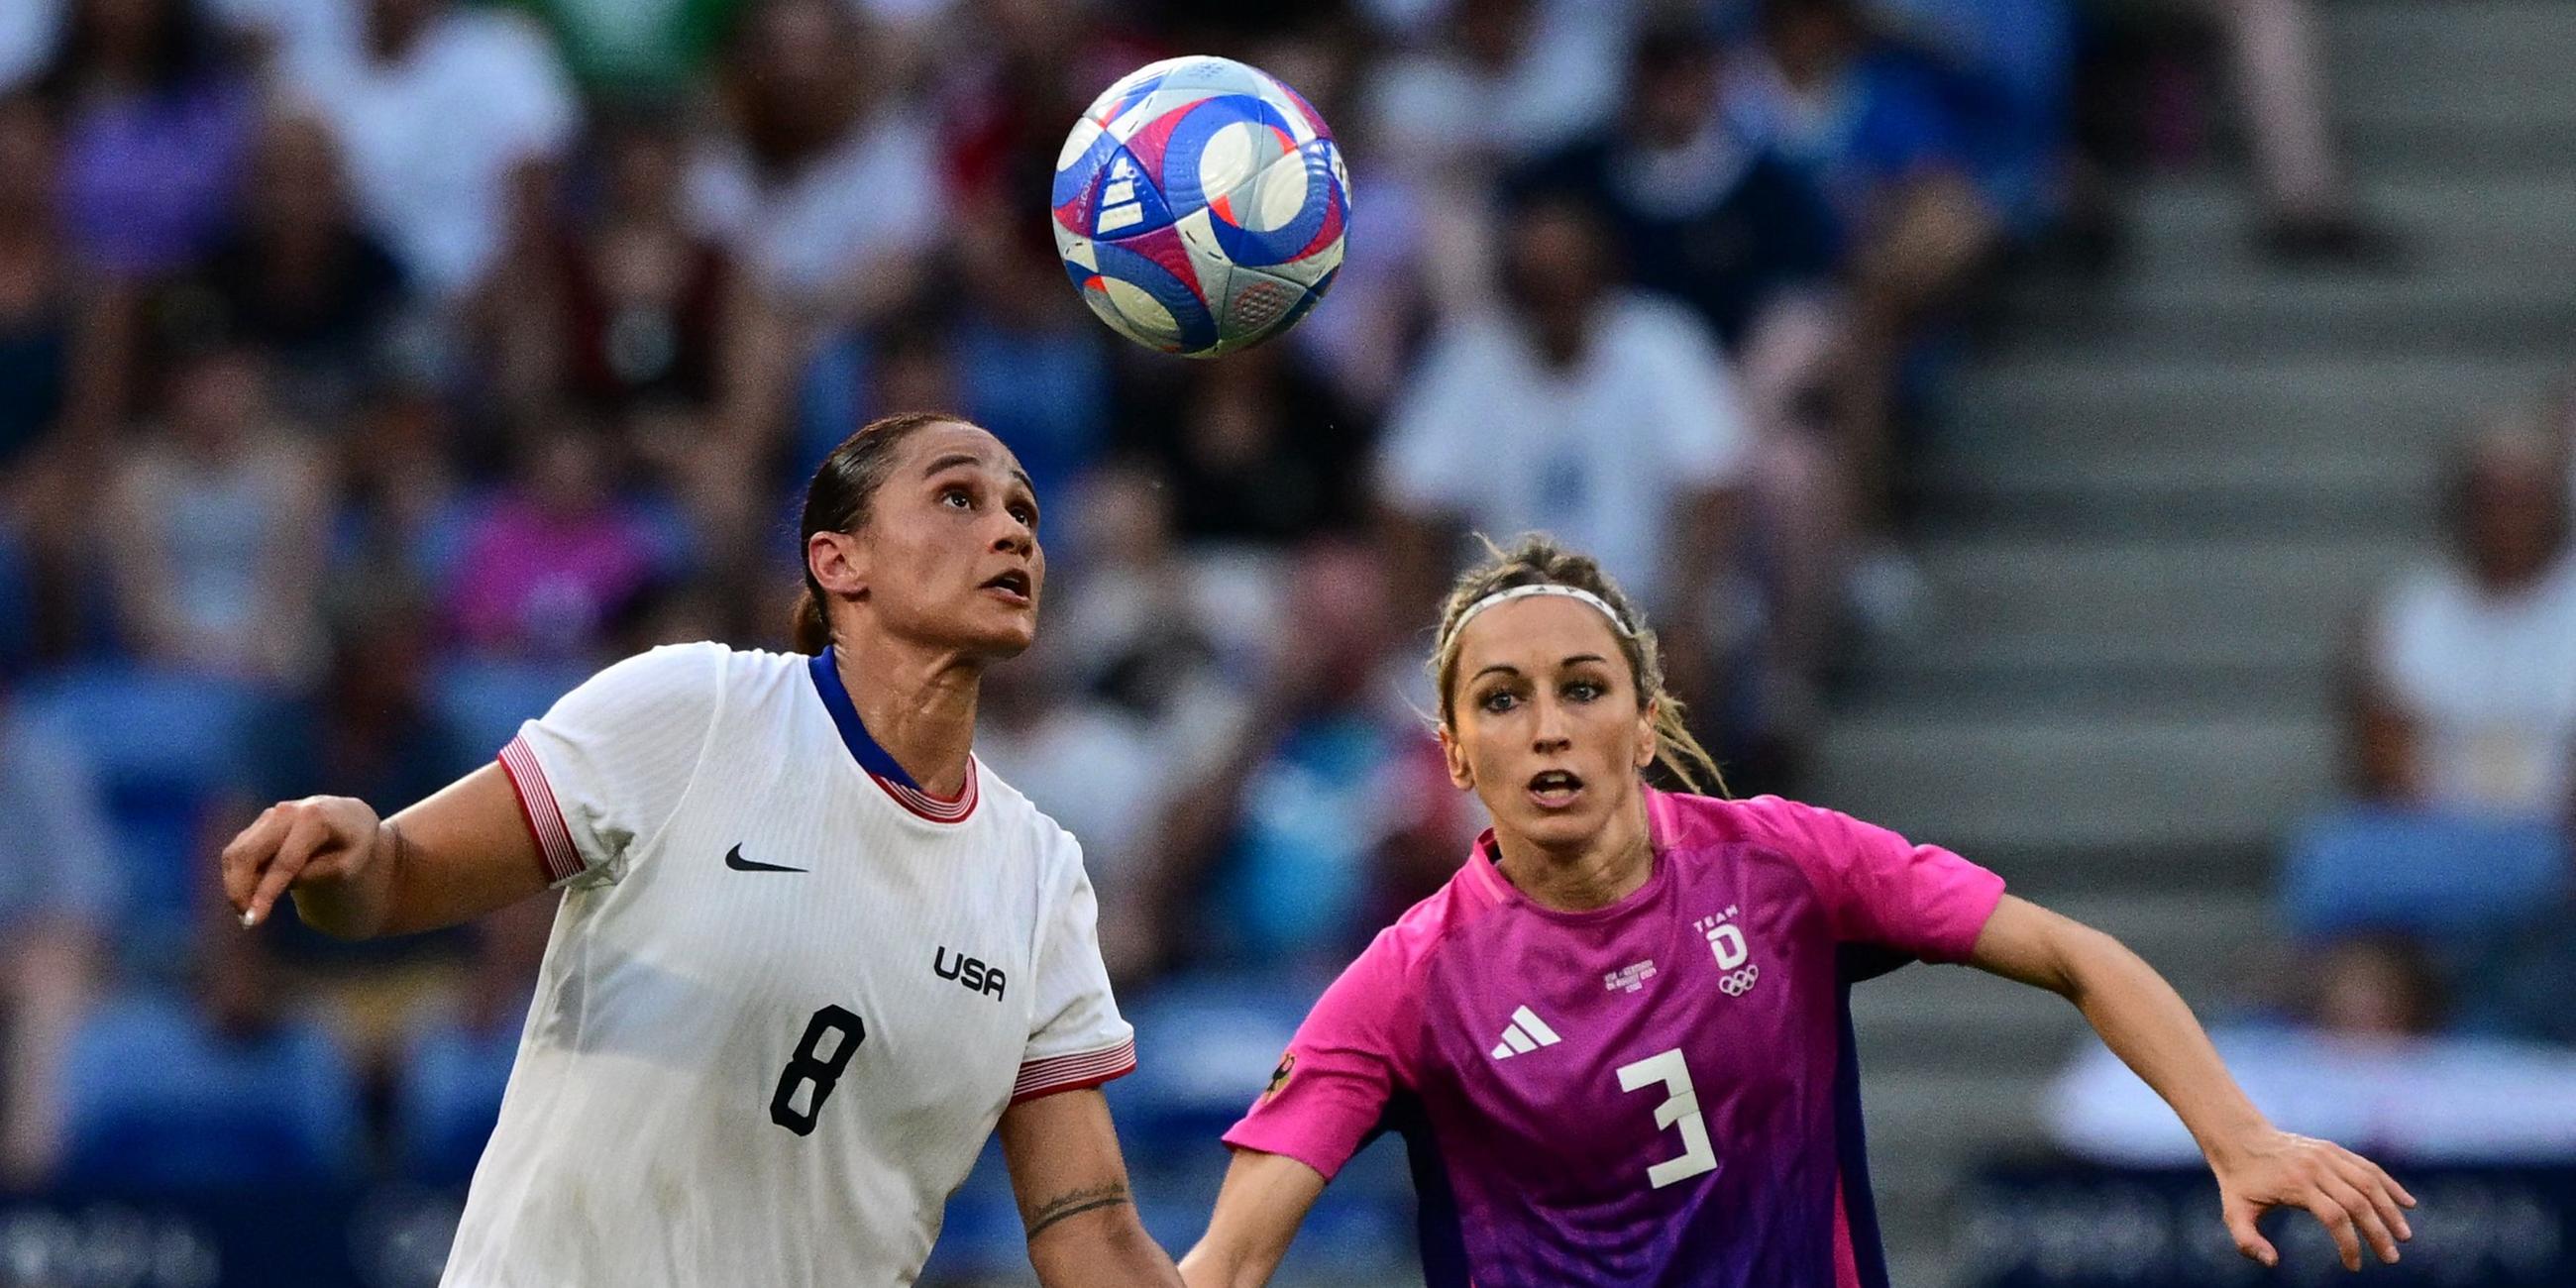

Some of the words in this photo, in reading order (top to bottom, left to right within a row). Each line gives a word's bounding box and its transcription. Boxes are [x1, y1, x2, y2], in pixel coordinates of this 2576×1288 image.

[1692, 904, 1739, 933] TEAM
[1706, 923, 1748, 970] D
[933, 945, 1007, 1003] USA
[769, 1004, 866, 1137] 8
[1616, 1047, 1718, 1190] 3
